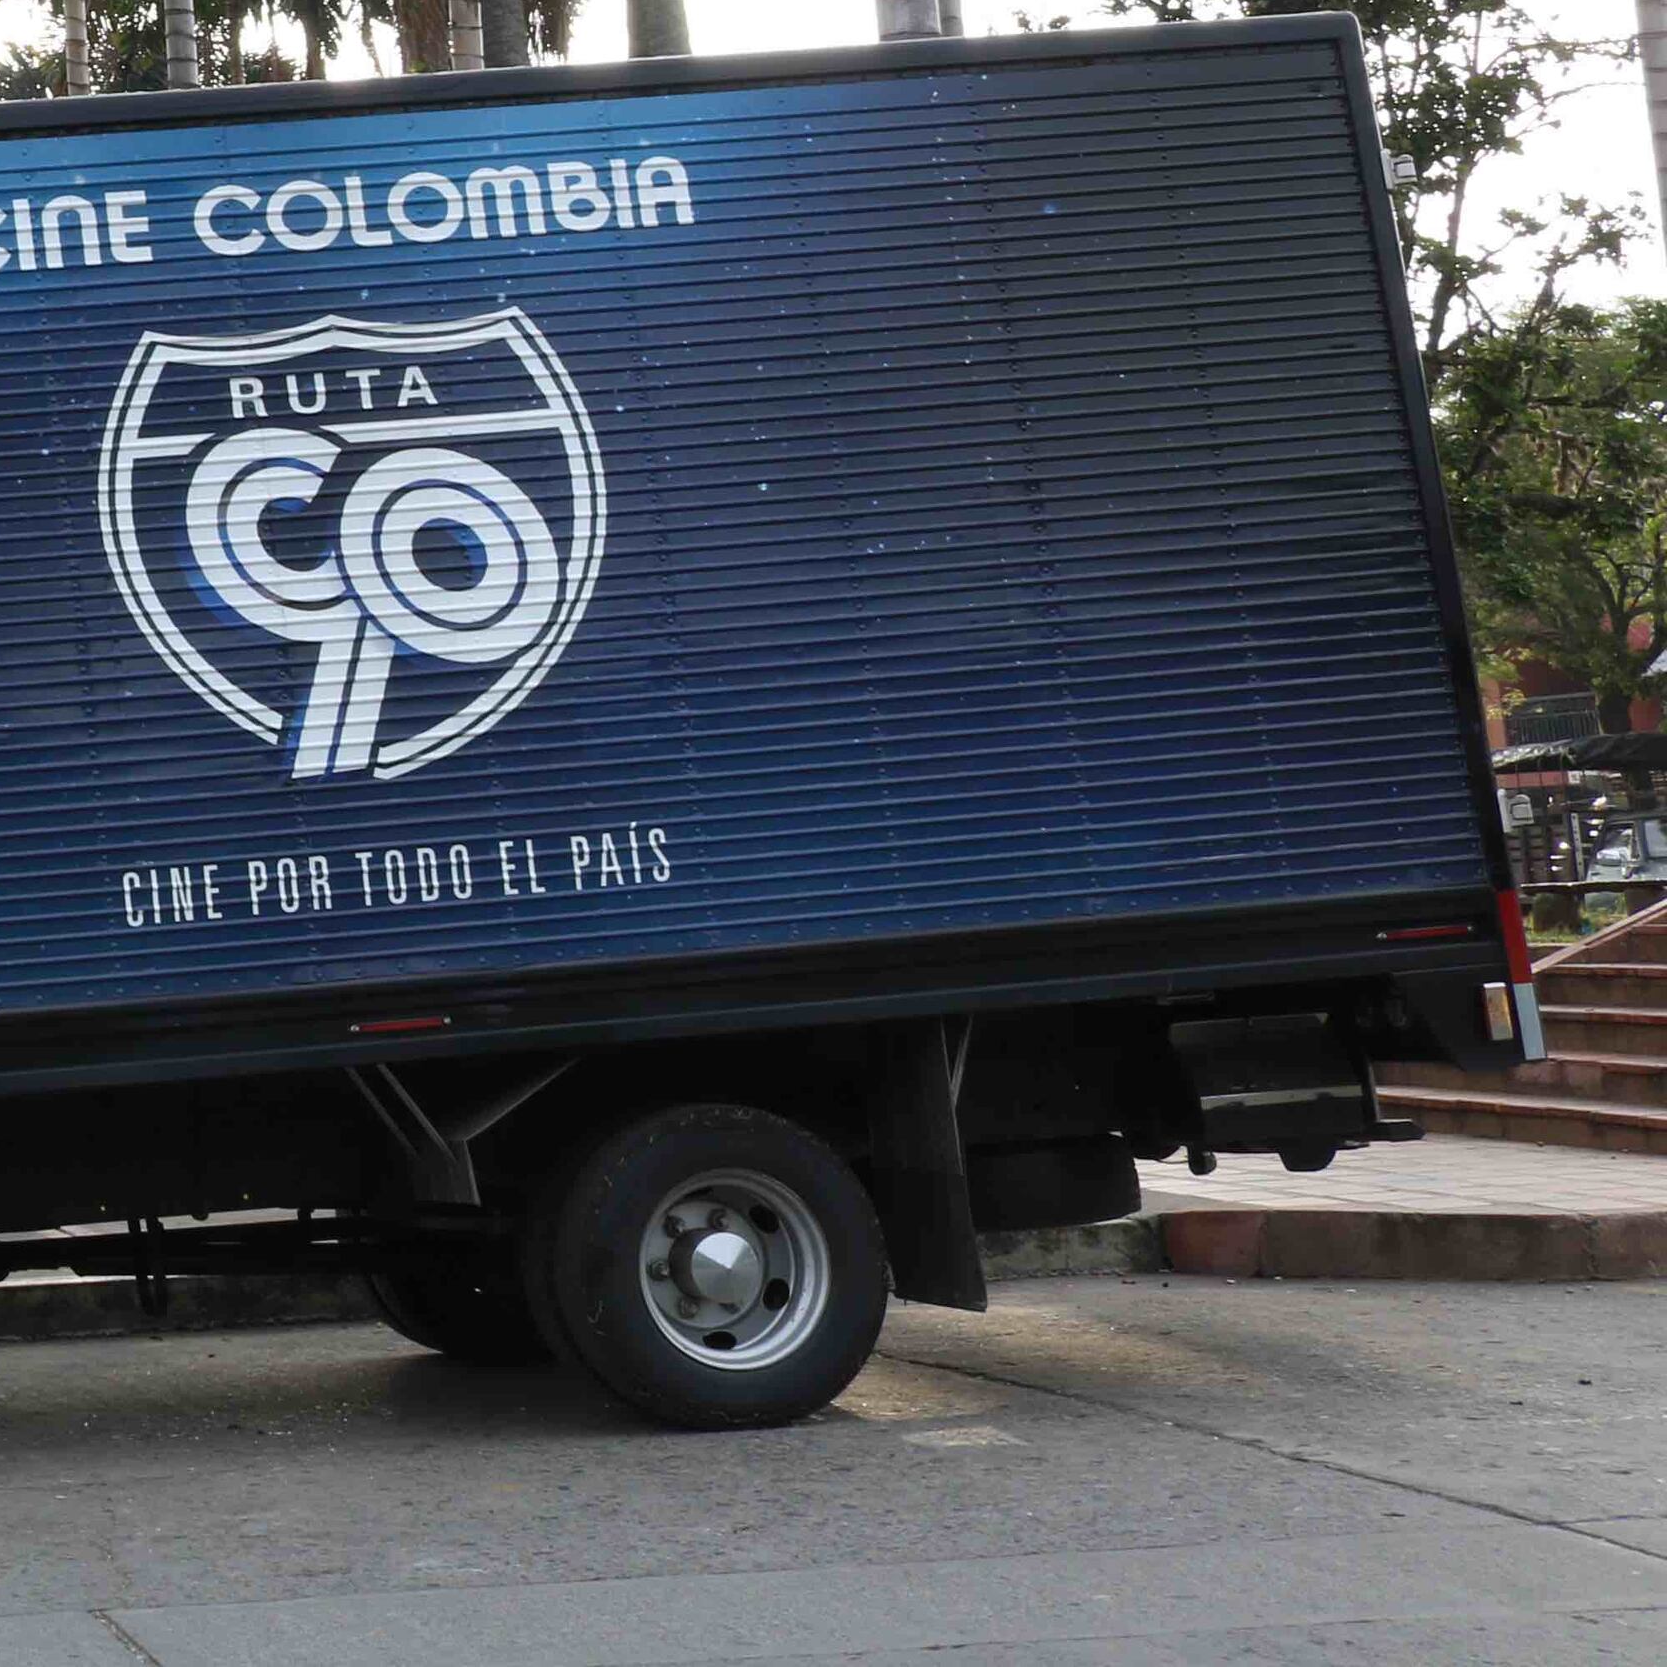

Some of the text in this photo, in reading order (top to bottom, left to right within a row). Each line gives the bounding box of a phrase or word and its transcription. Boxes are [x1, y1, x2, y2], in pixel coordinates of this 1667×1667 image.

[193, 156, 695, 256] COLOMBIA
[231, 365, 439, 420] RUTA
[122, 821, 672, 928] CINE POR TODO EL PAÍS
